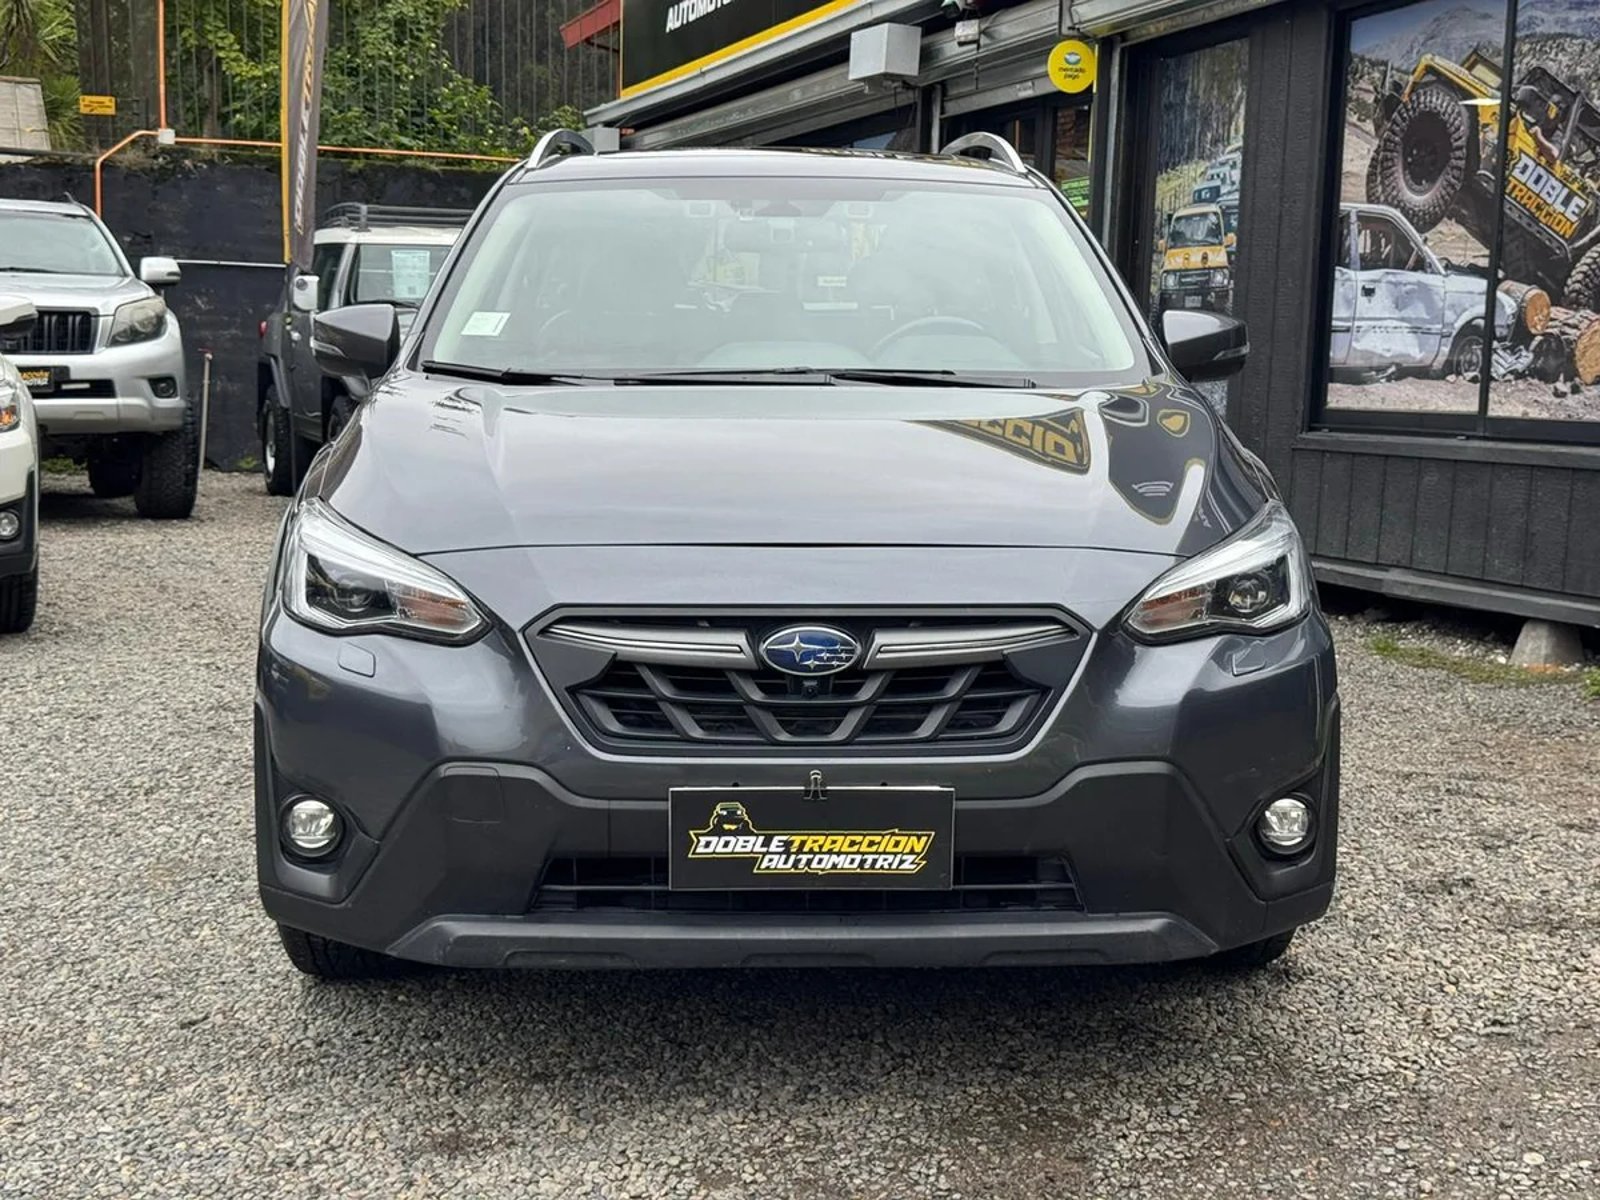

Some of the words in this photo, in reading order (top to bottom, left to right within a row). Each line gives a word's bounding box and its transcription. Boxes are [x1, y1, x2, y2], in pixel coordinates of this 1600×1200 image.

[665, 0, 733, 33] AUTOMO
[1511, 151, 1588, 223] DOBLE
[759, 853, 919, 870] AUTOMOTRIZ
